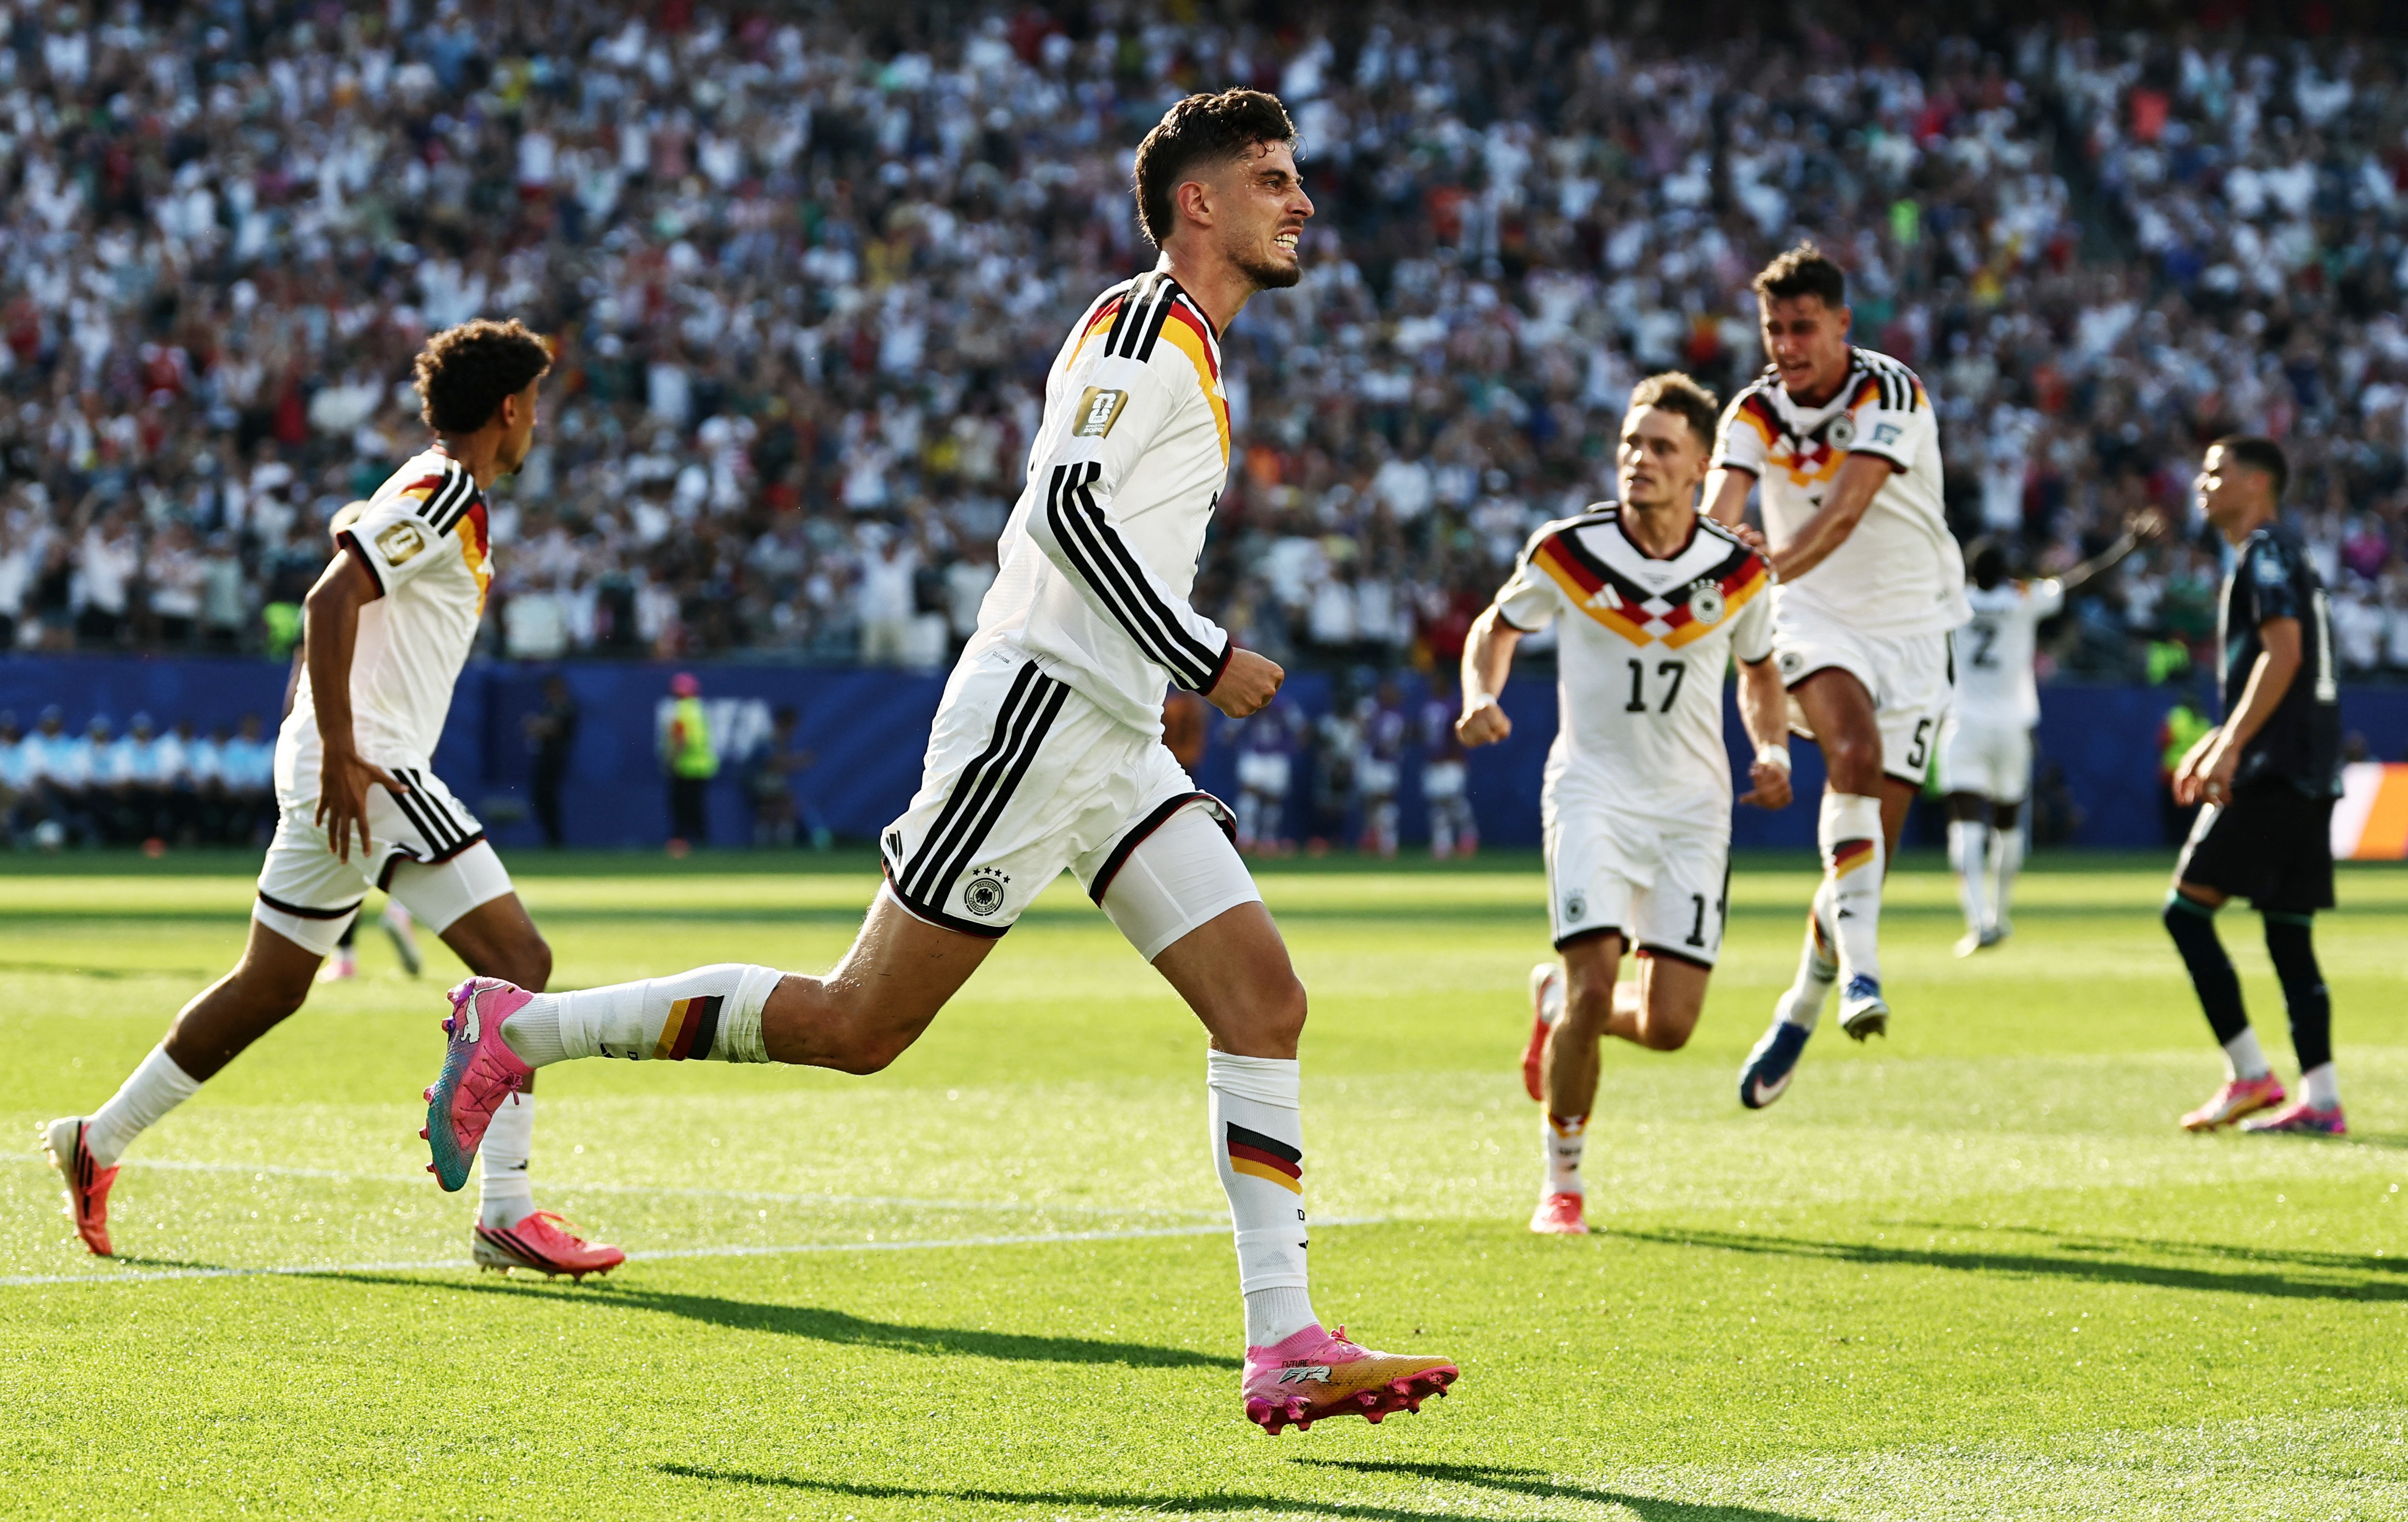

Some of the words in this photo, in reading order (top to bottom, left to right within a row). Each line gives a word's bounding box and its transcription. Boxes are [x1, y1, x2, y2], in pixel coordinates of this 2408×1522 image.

[1971, 620, 1998, 669] 2
[1625, 659, 1686, 713] 17
[1908, 719, 1930, 768] 5
[977, 882, 998, 892] DEUTSCHER
[970, 897, 995, 912] FUSSBALL-BUND
[1281, 1359, 1310, 1368] FUTURE
